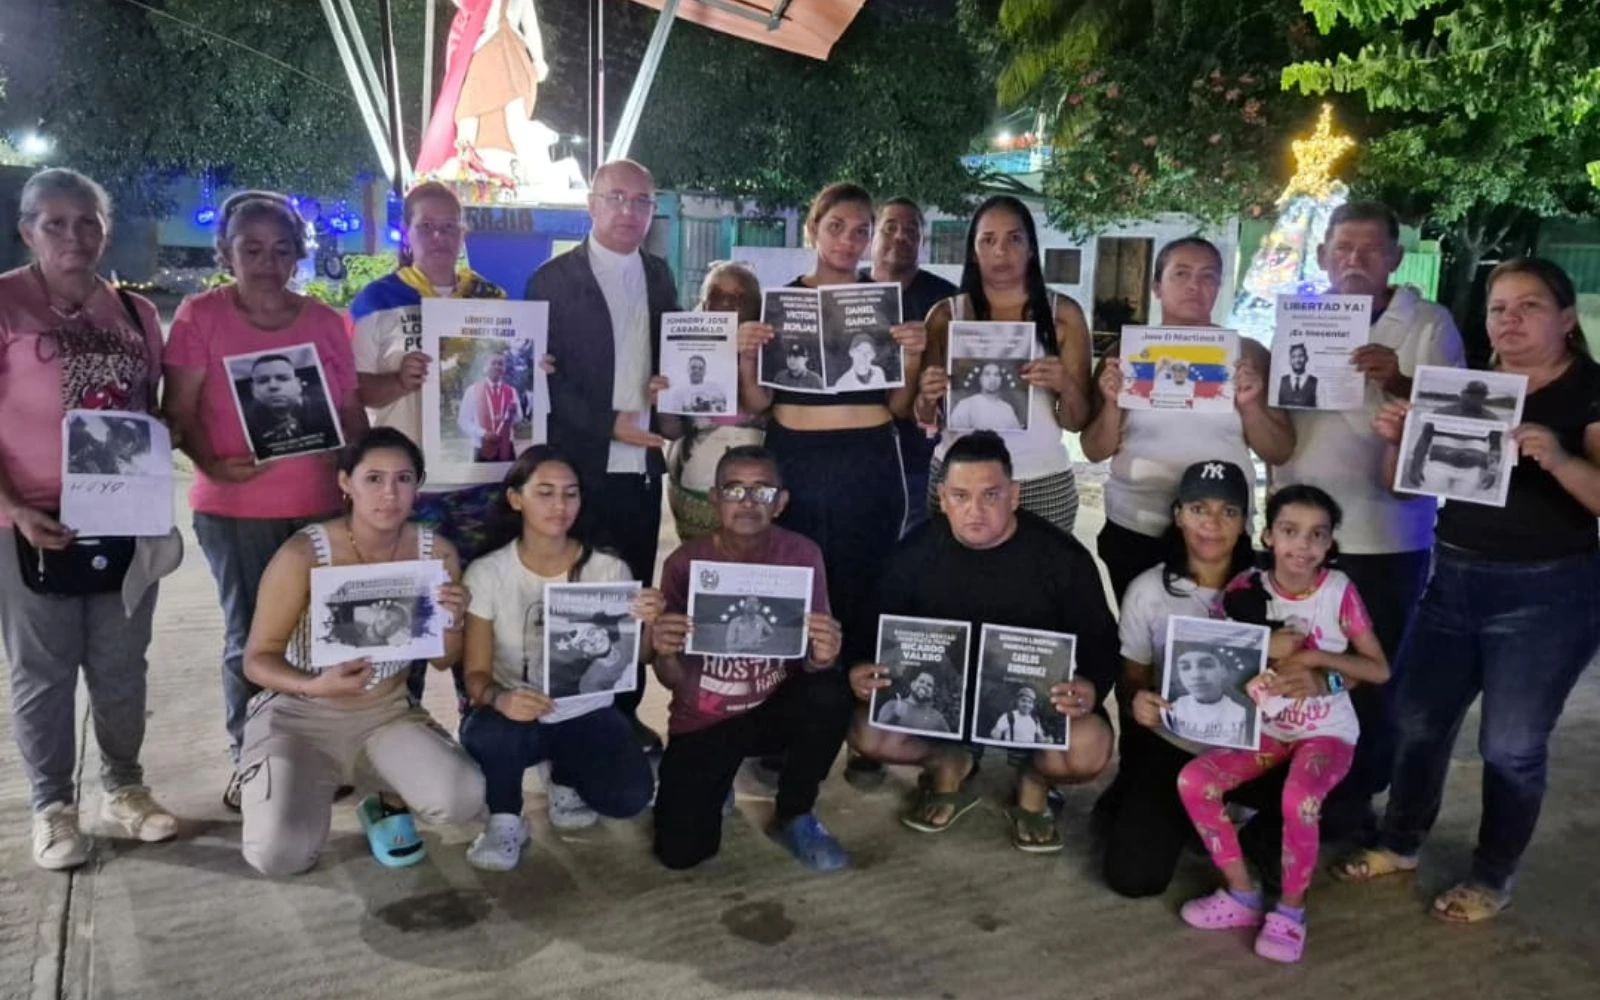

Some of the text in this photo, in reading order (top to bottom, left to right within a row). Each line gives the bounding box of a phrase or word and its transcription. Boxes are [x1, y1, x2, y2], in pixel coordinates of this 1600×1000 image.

[845, 305, 876, 315] DANIEL
[1283, 301, 1365, 312] LIBERTAD YA!
[786, 310, 817, 320] VICTOR
[901, 642, 945, 654] RICARDO
[902, 651, 942, 662] VALERO
[1012, 651, 1040, 665] CARLOS
